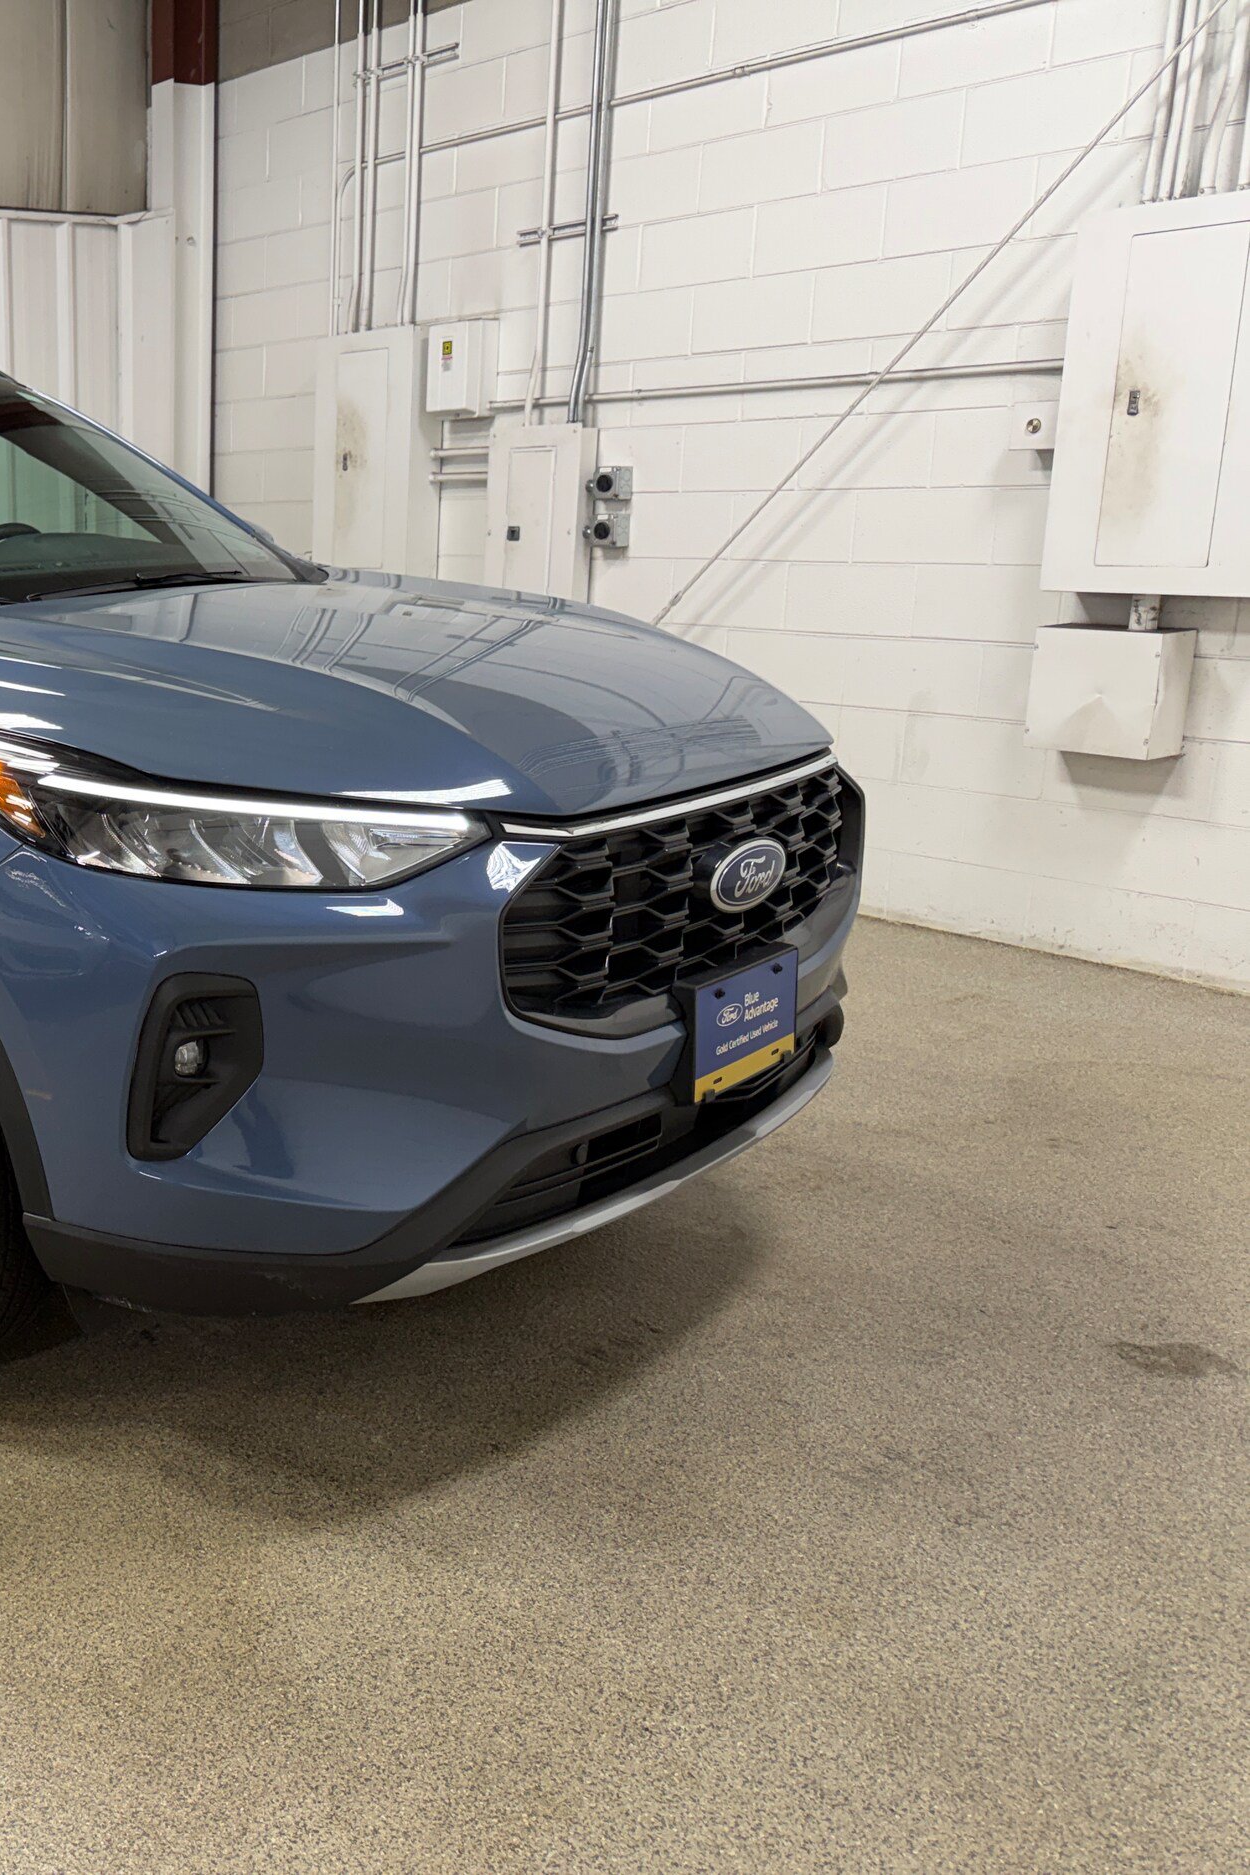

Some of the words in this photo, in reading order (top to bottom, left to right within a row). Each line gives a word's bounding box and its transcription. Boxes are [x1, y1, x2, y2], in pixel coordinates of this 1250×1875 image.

[734, 855, 775, 898] Ford
[743, 997, 779, 1022] Advantage
[744, 991, 760, 1007] Blue
[721, 1007, 738, 1024] Ford
[716, 1043, 728, 1055] Gold
[728, 1033, 749, 1049] Certified
[749, 1026, 762, 1039] Used
[762, 1019, 778, 1033] Vehicle
